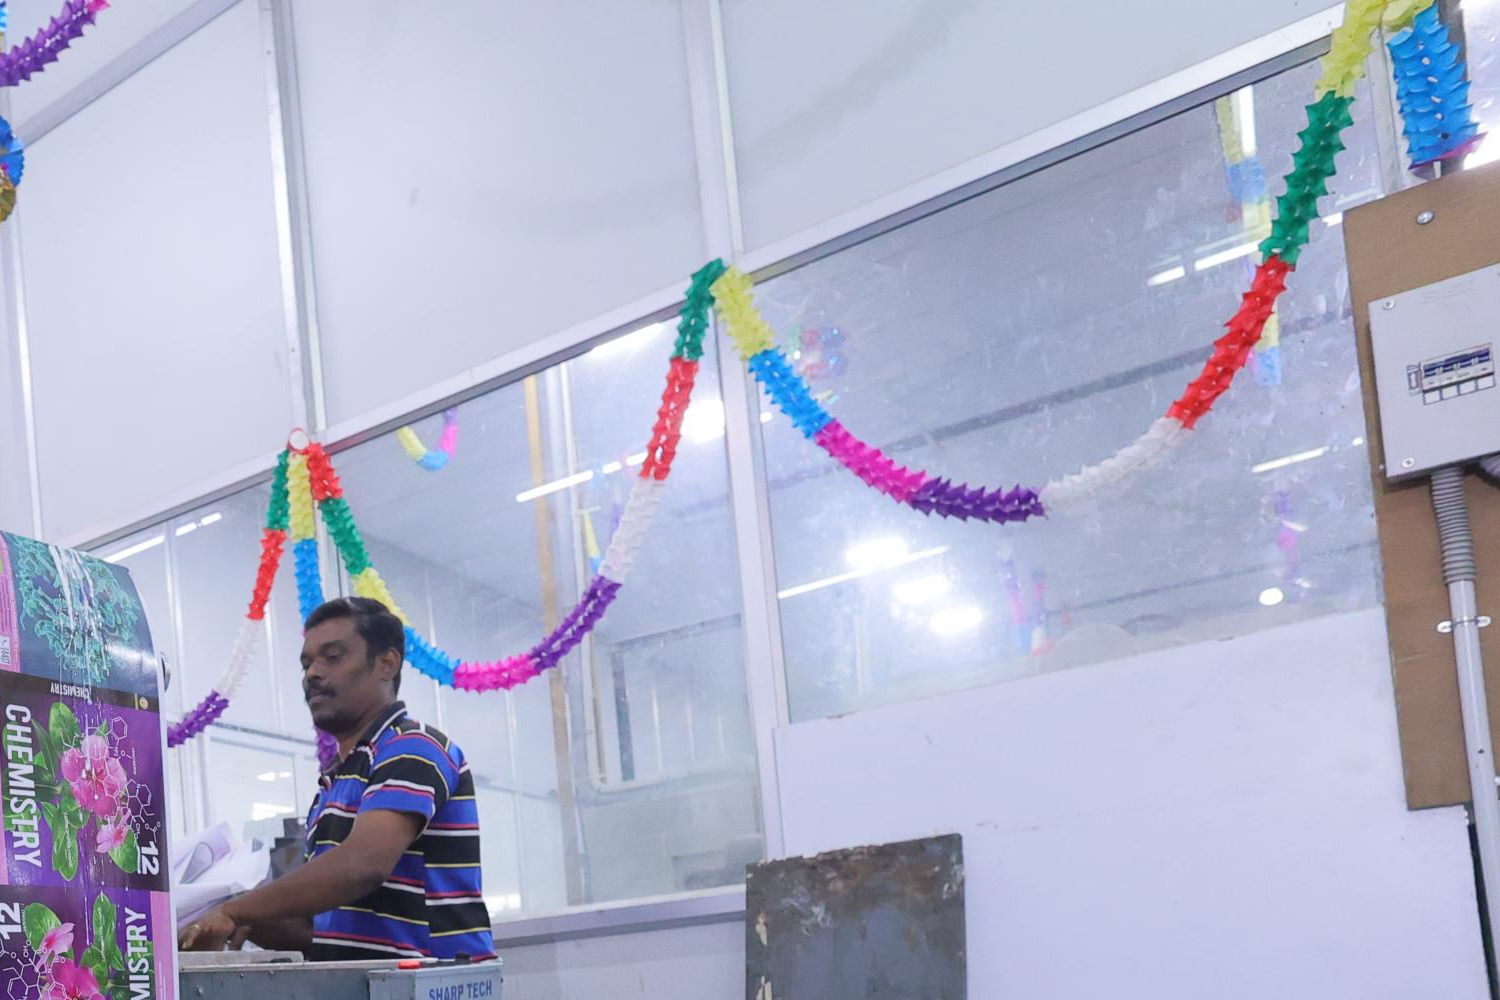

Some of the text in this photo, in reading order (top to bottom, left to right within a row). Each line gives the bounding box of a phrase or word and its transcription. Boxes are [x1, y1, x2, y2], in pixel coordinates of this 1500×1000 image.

[50, 682, 90, 699] CHEMISTRY
[4, 703, 42, 868] CHEMISTRY
[140, 840, 160, 876] 12
[467, 980, 492, 999] TECH
